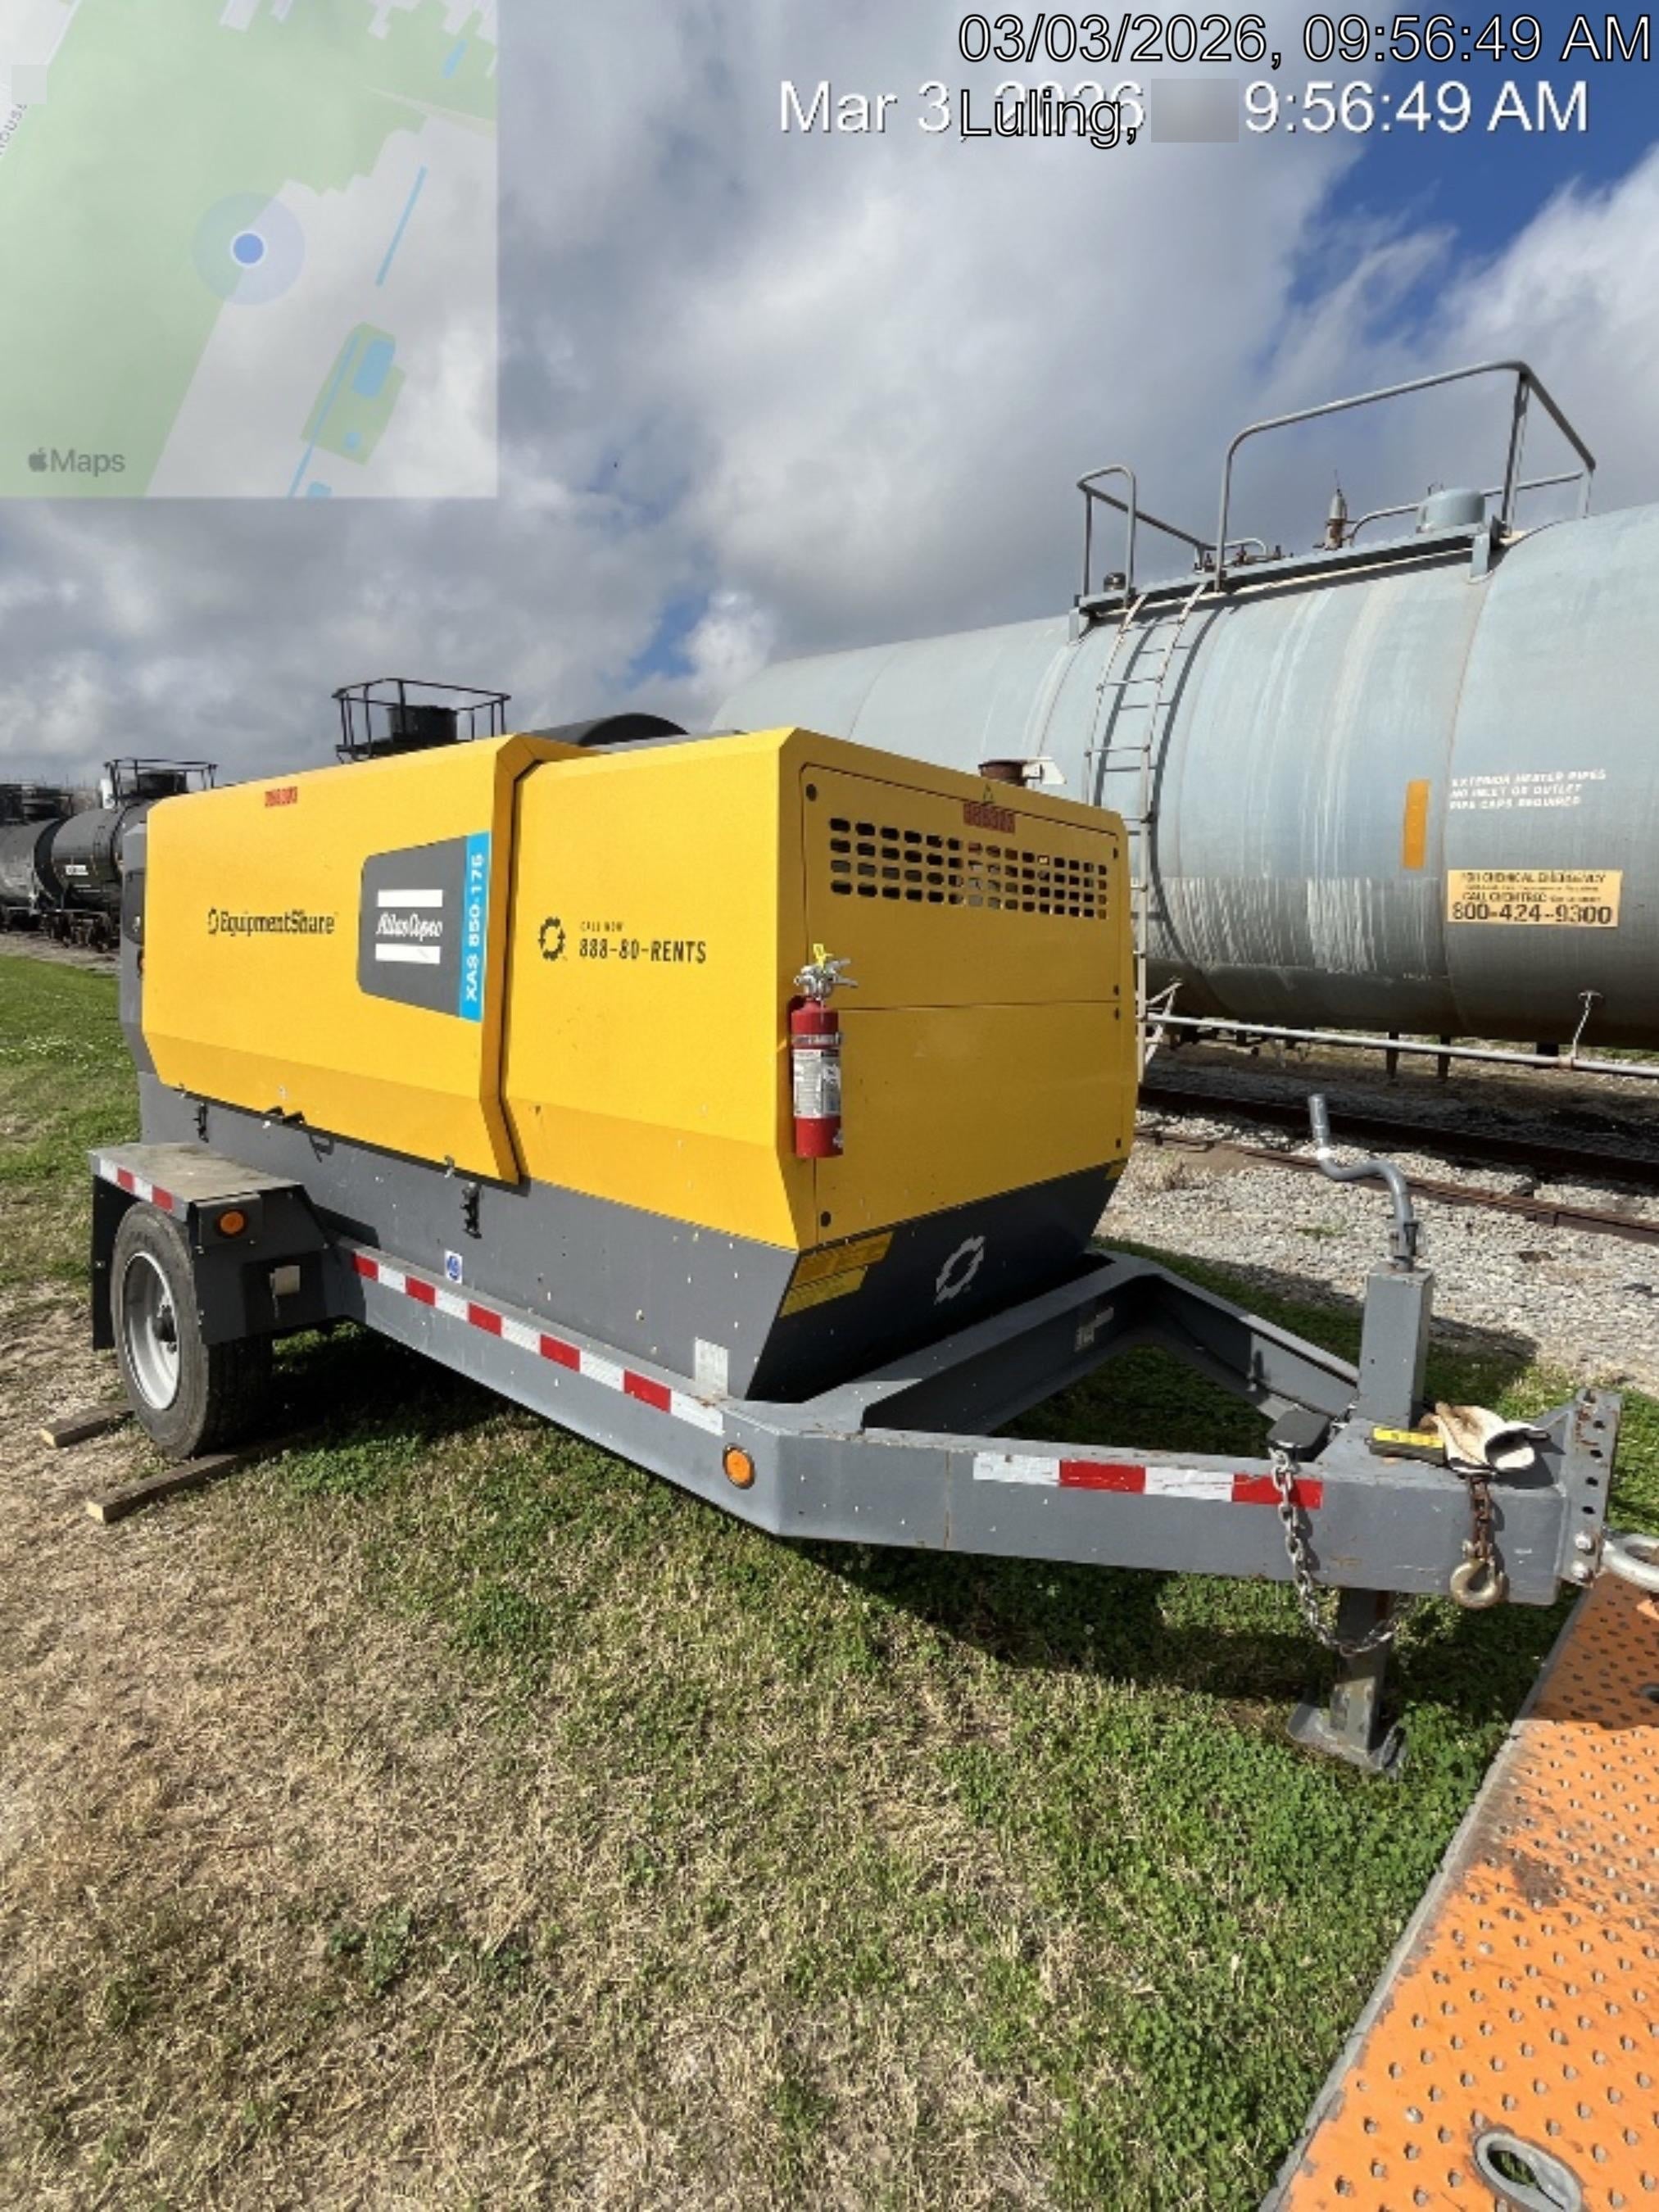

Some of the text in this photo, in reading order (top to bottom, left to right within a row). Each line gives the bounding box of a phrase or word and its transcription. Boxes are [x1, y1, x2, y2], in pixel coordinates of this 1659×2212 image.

[220, 909, 335, 937] EquipmentShare
[1453, 901, 1612, 925] 800-424-9300
[579, 938, 707, 964] 888-80-RENTS
[465, 953, 480, 1003] XAS
